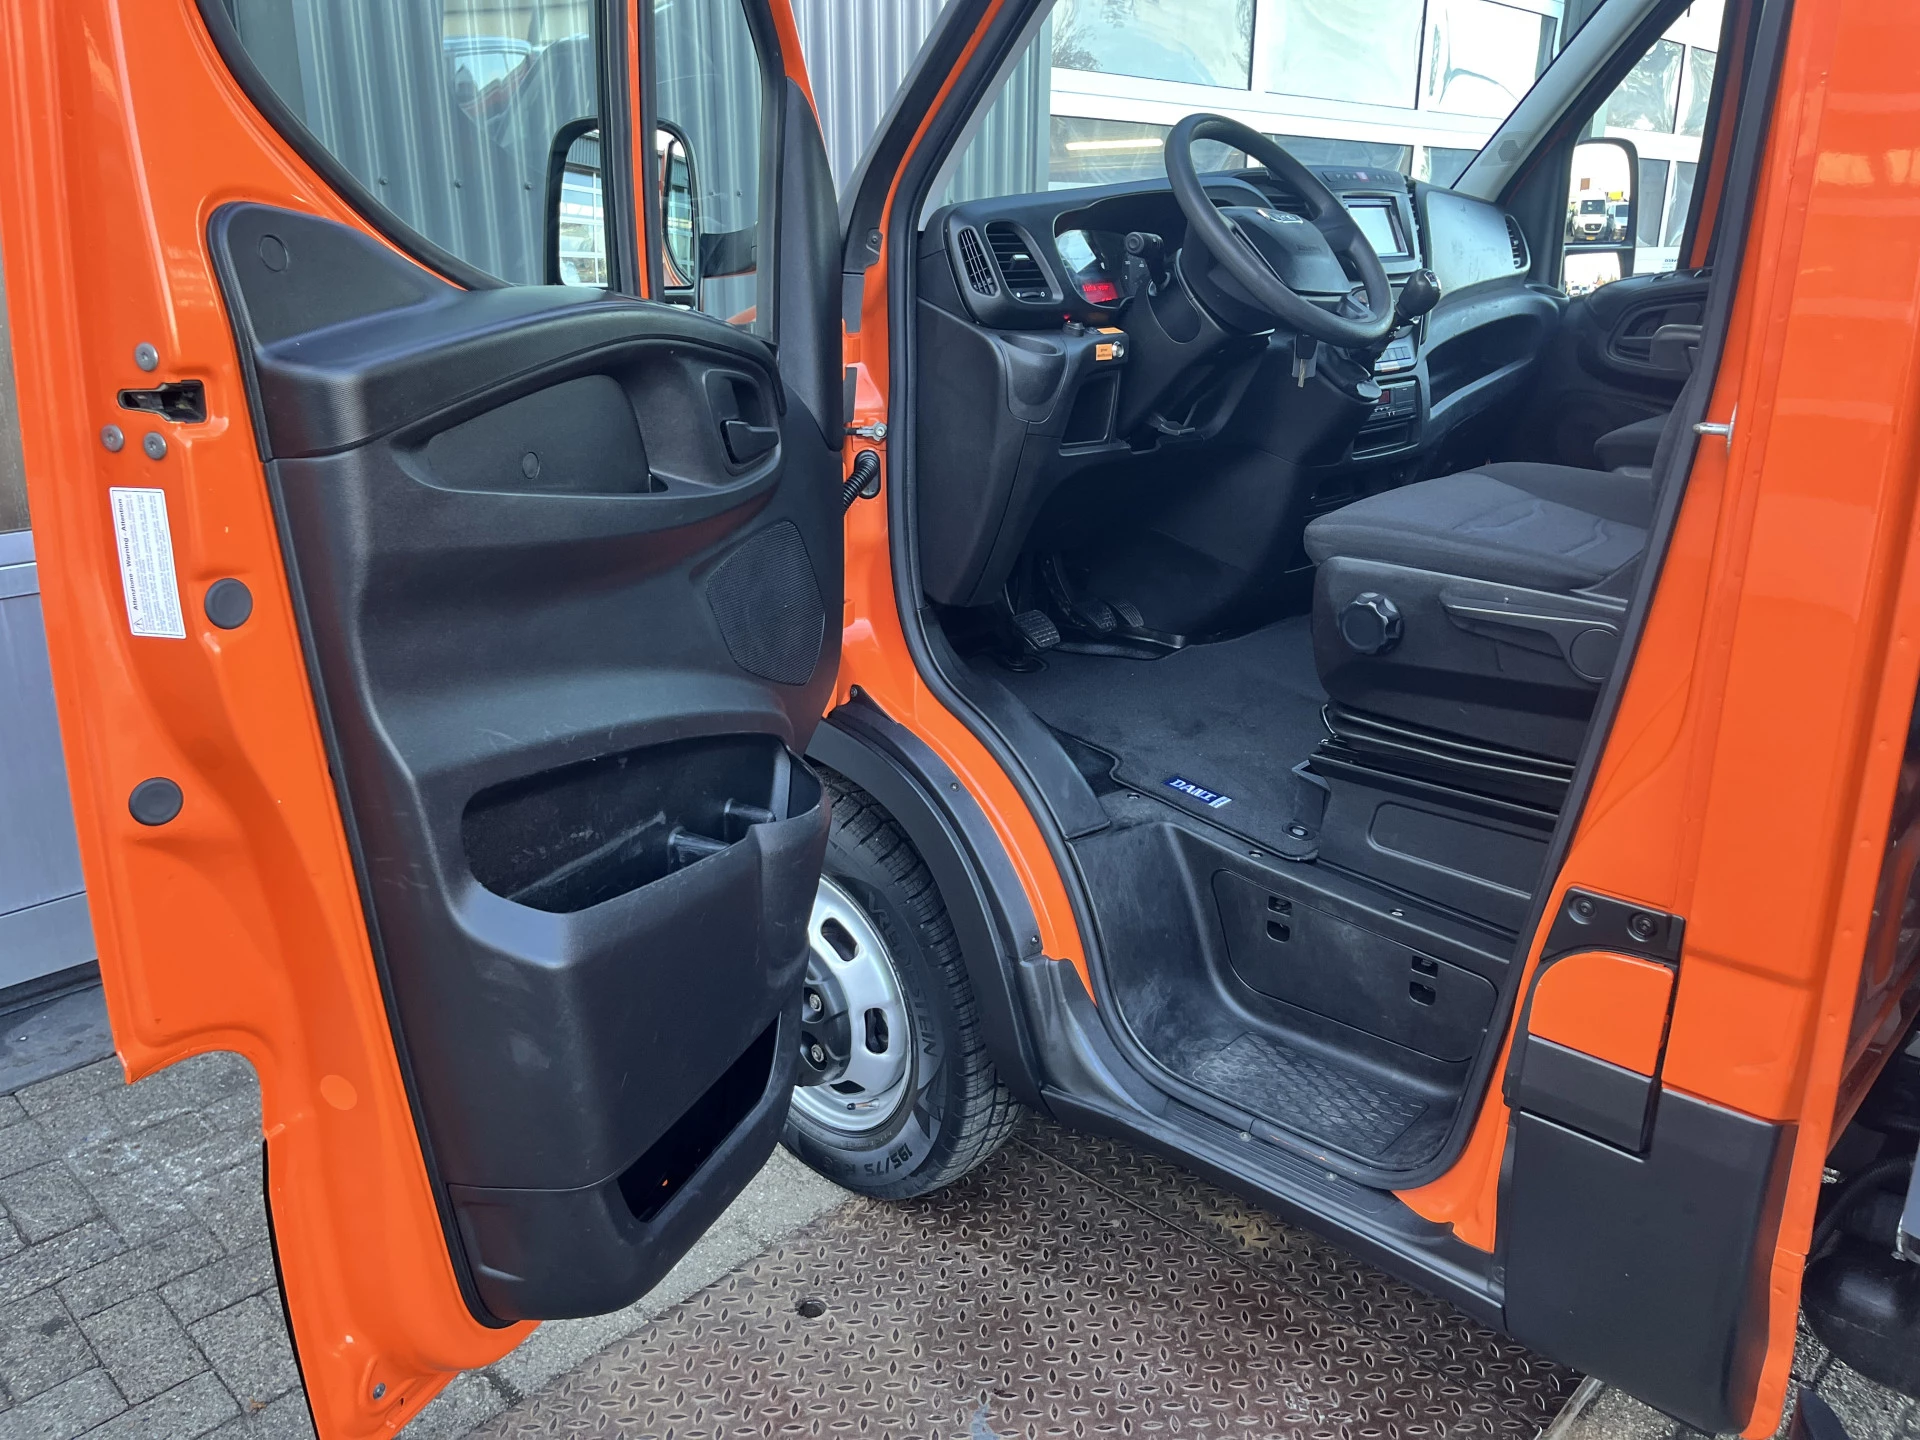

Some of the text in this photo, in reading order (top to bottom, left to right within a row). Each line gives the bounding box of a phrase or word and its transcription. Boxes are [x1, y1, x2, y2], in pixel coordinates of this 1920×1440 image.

[118, 498, 126, 531] Attention
[123, 536, 132, 567] Warning
[129, 572, 139, 610] Attenzione
[864, 1143, 913, 1177] 195/75
